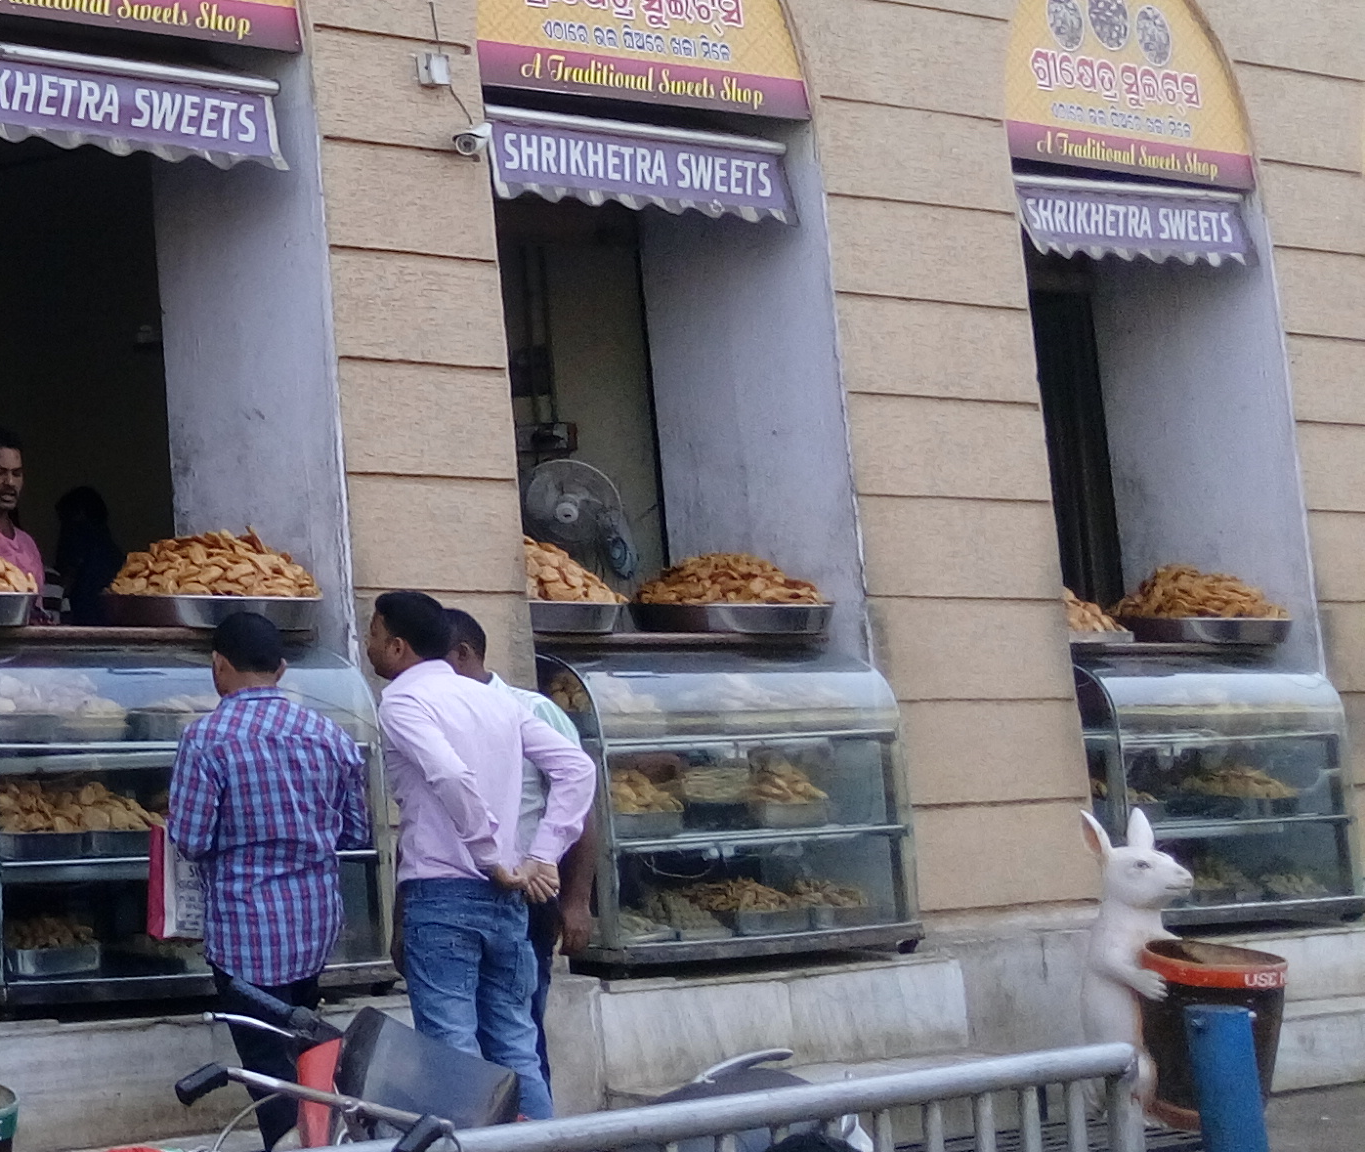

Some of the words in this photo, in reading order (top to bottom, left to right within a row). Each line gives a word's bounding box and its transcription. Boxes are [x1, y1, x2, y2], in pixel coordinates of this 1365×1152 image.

[195, 3, 251, 40] Shop
[521, 53, 542, 78] A
[547, 55, 653, 92] Traditional
[658, 68, 715, 98] Sweets
[720, 76, 764, 110] Shop
[131, 88, 256, 142] SWEETS
[504, 134, 668, 186] SHRIKHETRA
[677, 153, 772, 197] SWEETS
[1026, 199, 1152, 240] SHRIKHETRA
[1158, 209, 1233, 243] SWEETS
[1244, 973, 1277, 987] USE
